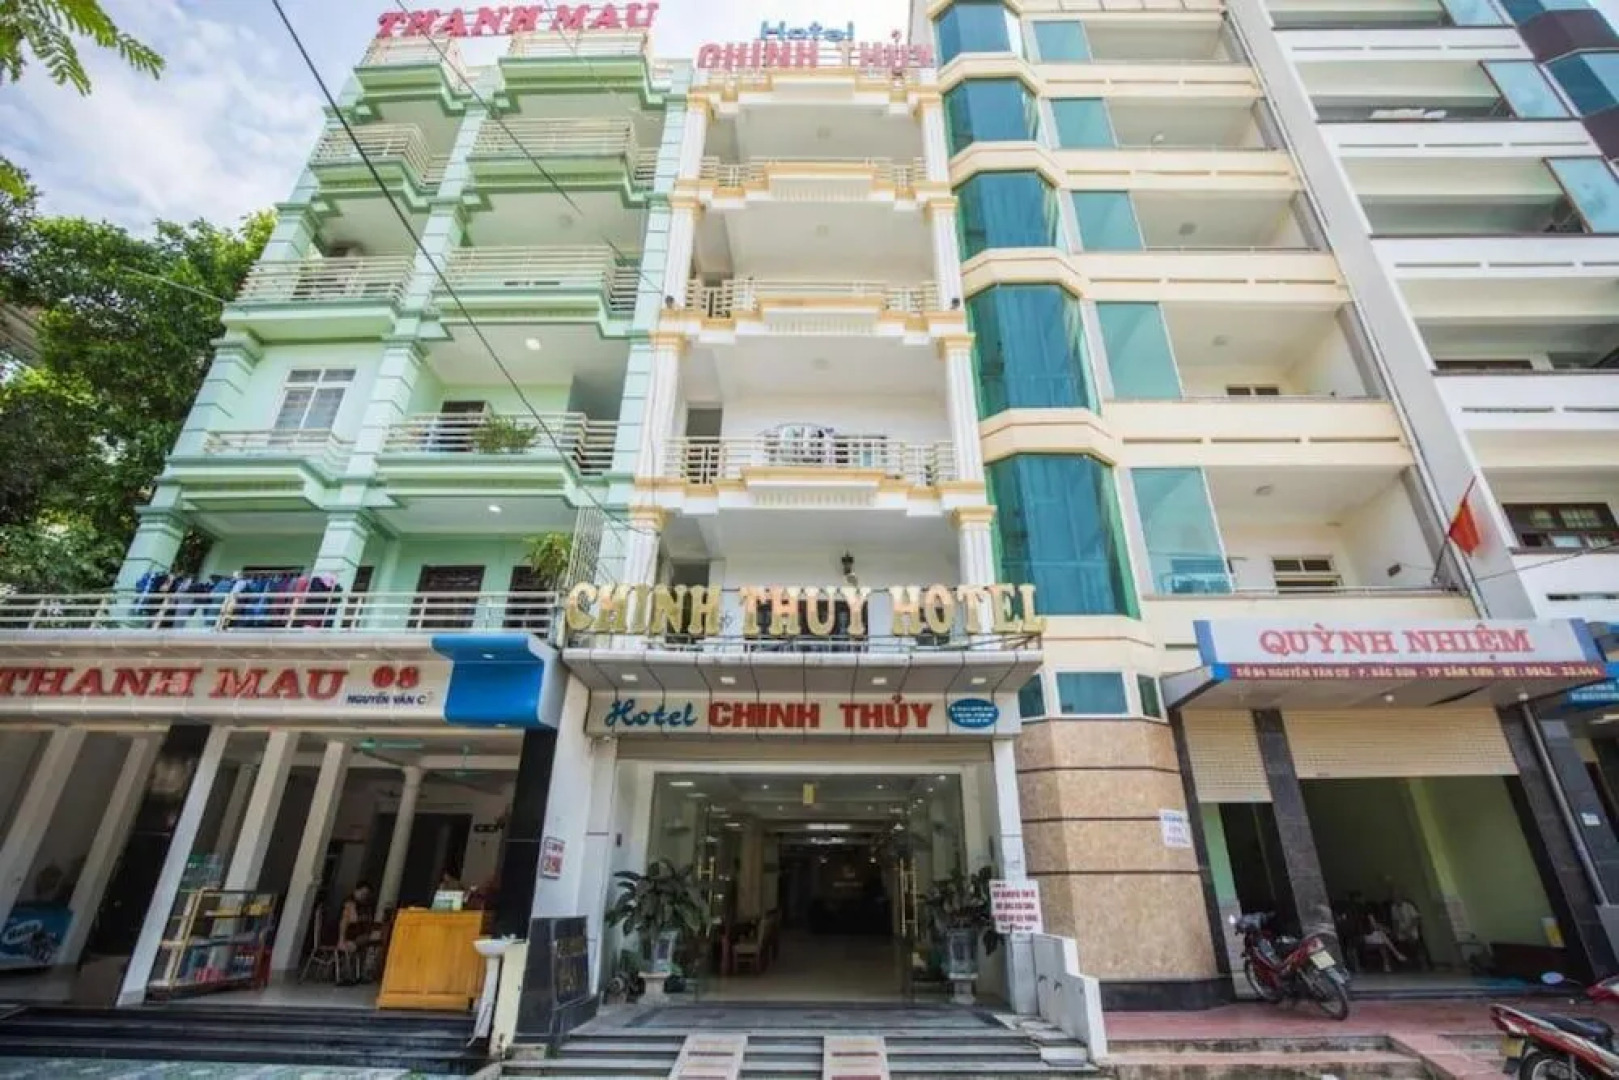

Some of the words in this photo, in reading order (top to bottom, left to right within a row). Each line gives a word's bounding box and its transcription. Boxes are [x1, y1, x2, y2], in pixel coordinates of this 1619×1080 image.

[375, 7, 543, 38] THANH
[552, 2, 659, 30] MAU
[760, 20, 854, 42] Hotel
[697, 39, 819, 69] CHINH
[564, 583, 721, 636] CHINH
[740, 584, 871, 639] THUY
[889, 583, 1046, 636] HOTEL
[1259, 622, 1399, 656] QUỲNH
[1402, 622, 1535, 660] NHIỆM
[0, 667, 202, 697] THANH
[209, 667, 348, 700] MAU
[372, 666, 419, 688] 08
[604, 698, 697, 728] Hotel
[708, 702, 819, 728] CHINH
[839, 694, 933, 728] THỦY
